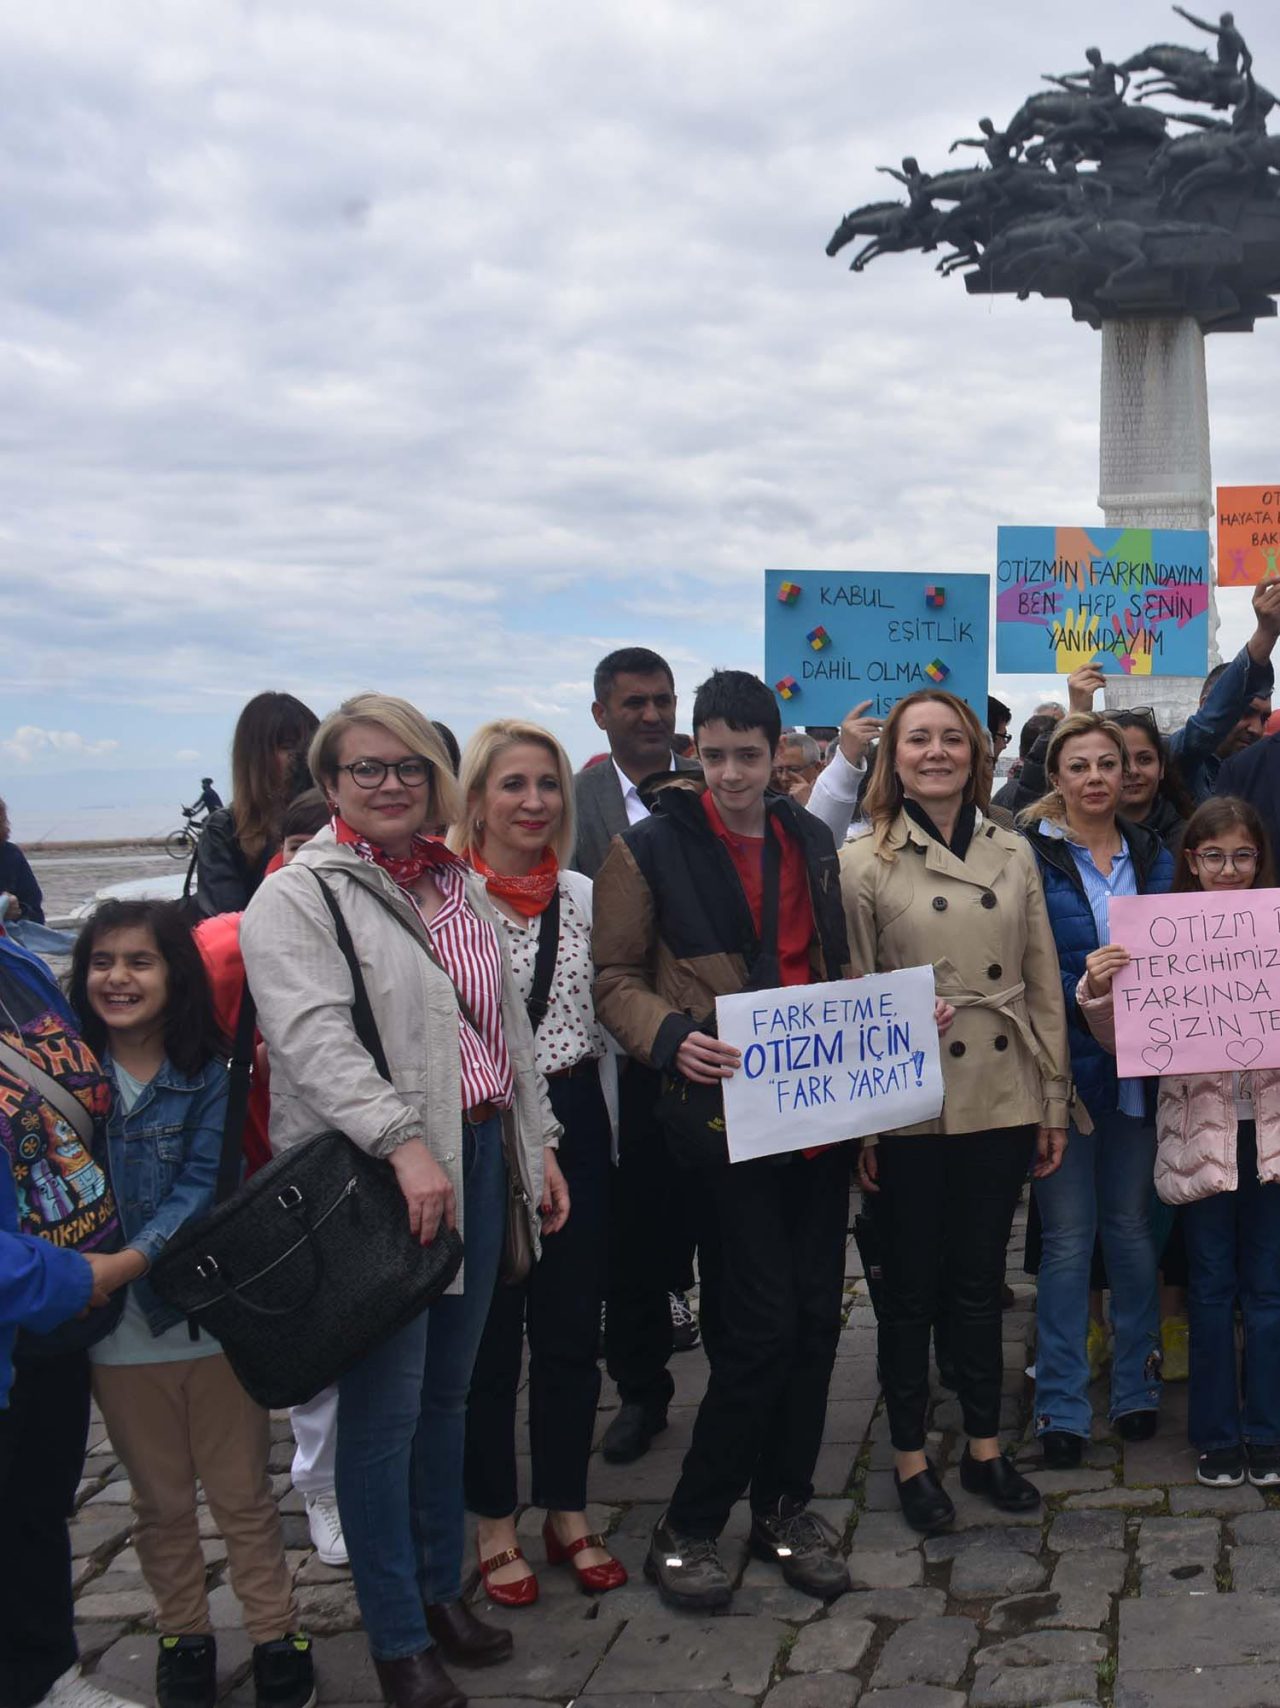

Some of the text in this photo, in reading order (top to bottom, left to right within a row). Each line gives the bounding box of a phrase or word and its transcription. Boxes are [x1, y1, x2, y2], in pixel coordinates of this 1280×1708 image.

[1220, 512, 1274, 526] HAYATA
[997, 556, 1203, 587] OTİZMİN FARKINDAYIM
[820, 585, 895, 609] KABUL
[1018, 591, 1193, 619] BEN HEP SENİN
[888, 617, 974, 643] EŞİTLİK
[1046, 627, 1164, 656] YANINDAYIM
[802, 656, 924, 683] DAHİL OLMA
[1150, 909, 1257, 947] OTİZM
[1122, 978, 1272, 1011] FARKINDA
[753, 1002, 816, 1036] FARK
[1149, 1010, 1242, 1045] SİZİN
[743, 1019, 910, 1079] OTİZM İÇİN
